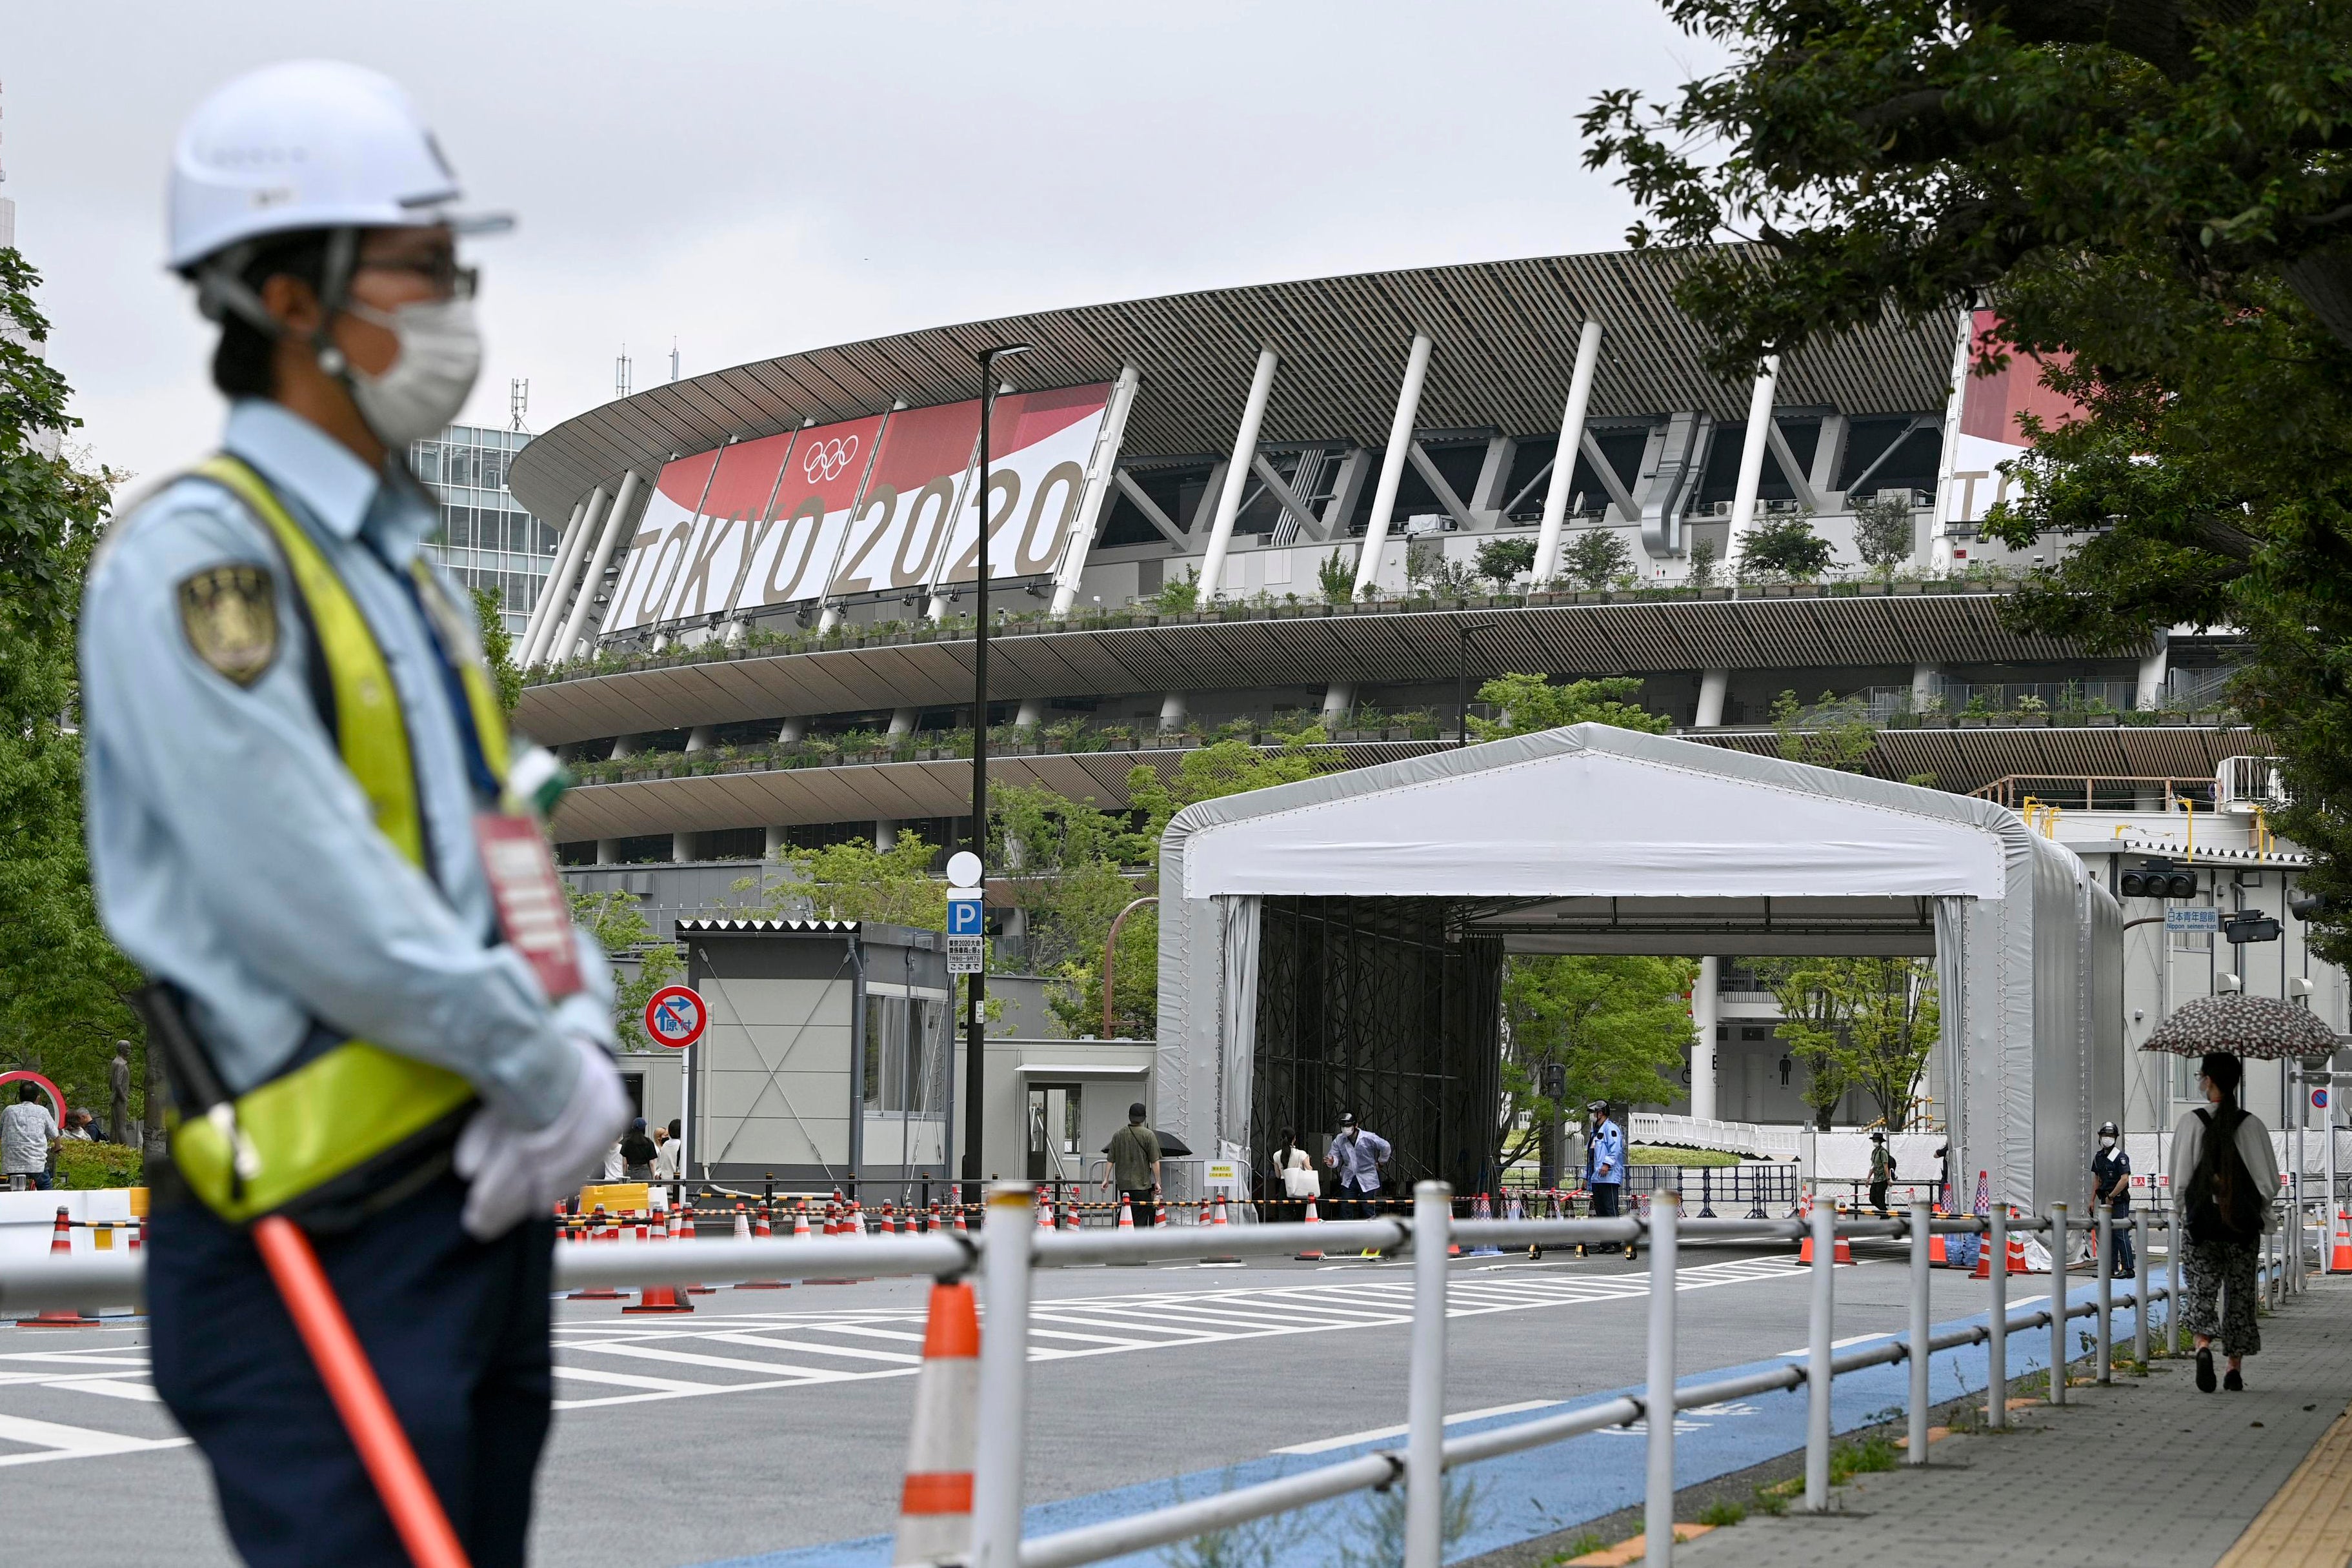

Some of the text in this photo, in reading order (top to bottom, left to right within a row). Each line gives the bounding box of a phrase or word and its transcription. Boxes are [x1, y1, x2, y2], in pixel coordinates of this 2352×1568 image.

[609, 461, 1083, 627] TOKYO 2020
[956, 904, 976, 932] P
[2168, 911, 2216, 922] 日本青年館前
[666, 1019, 692, 1032] 原付
[2131, 1177, 2145, 1186] 進入
